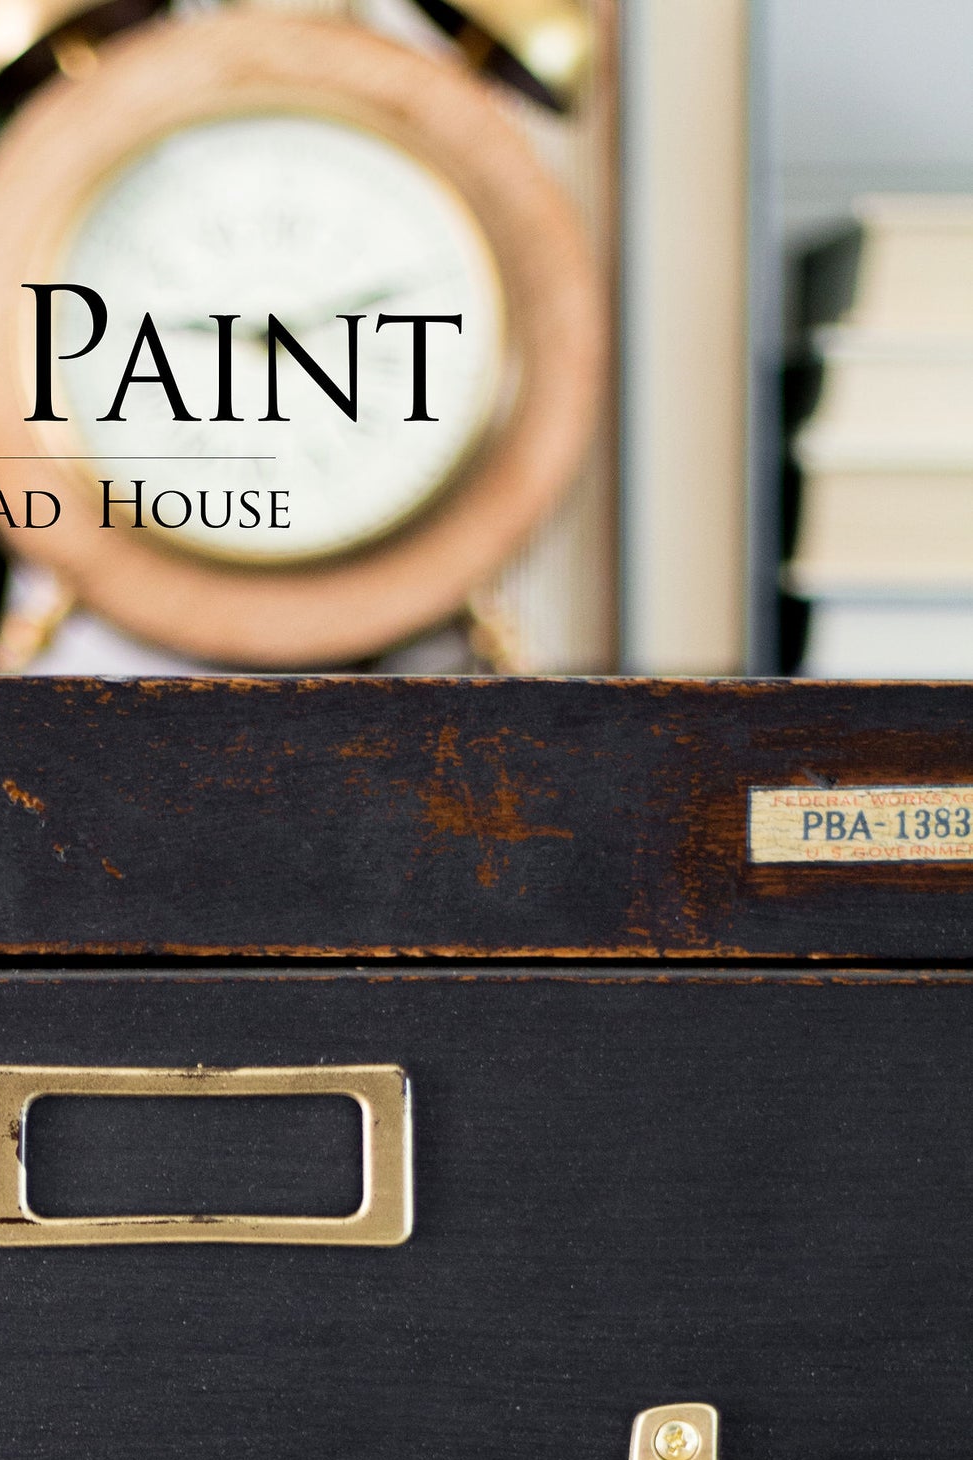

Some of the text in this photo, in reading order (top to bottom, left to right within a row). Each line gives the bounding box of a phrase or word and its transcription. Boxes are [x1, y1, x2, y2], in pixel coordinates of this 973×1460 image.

[770, 794, 864, 808] FEDERAL
[870, 793, 943, 807] WORKS
[802, 807, 972, 841] PBA-1383
